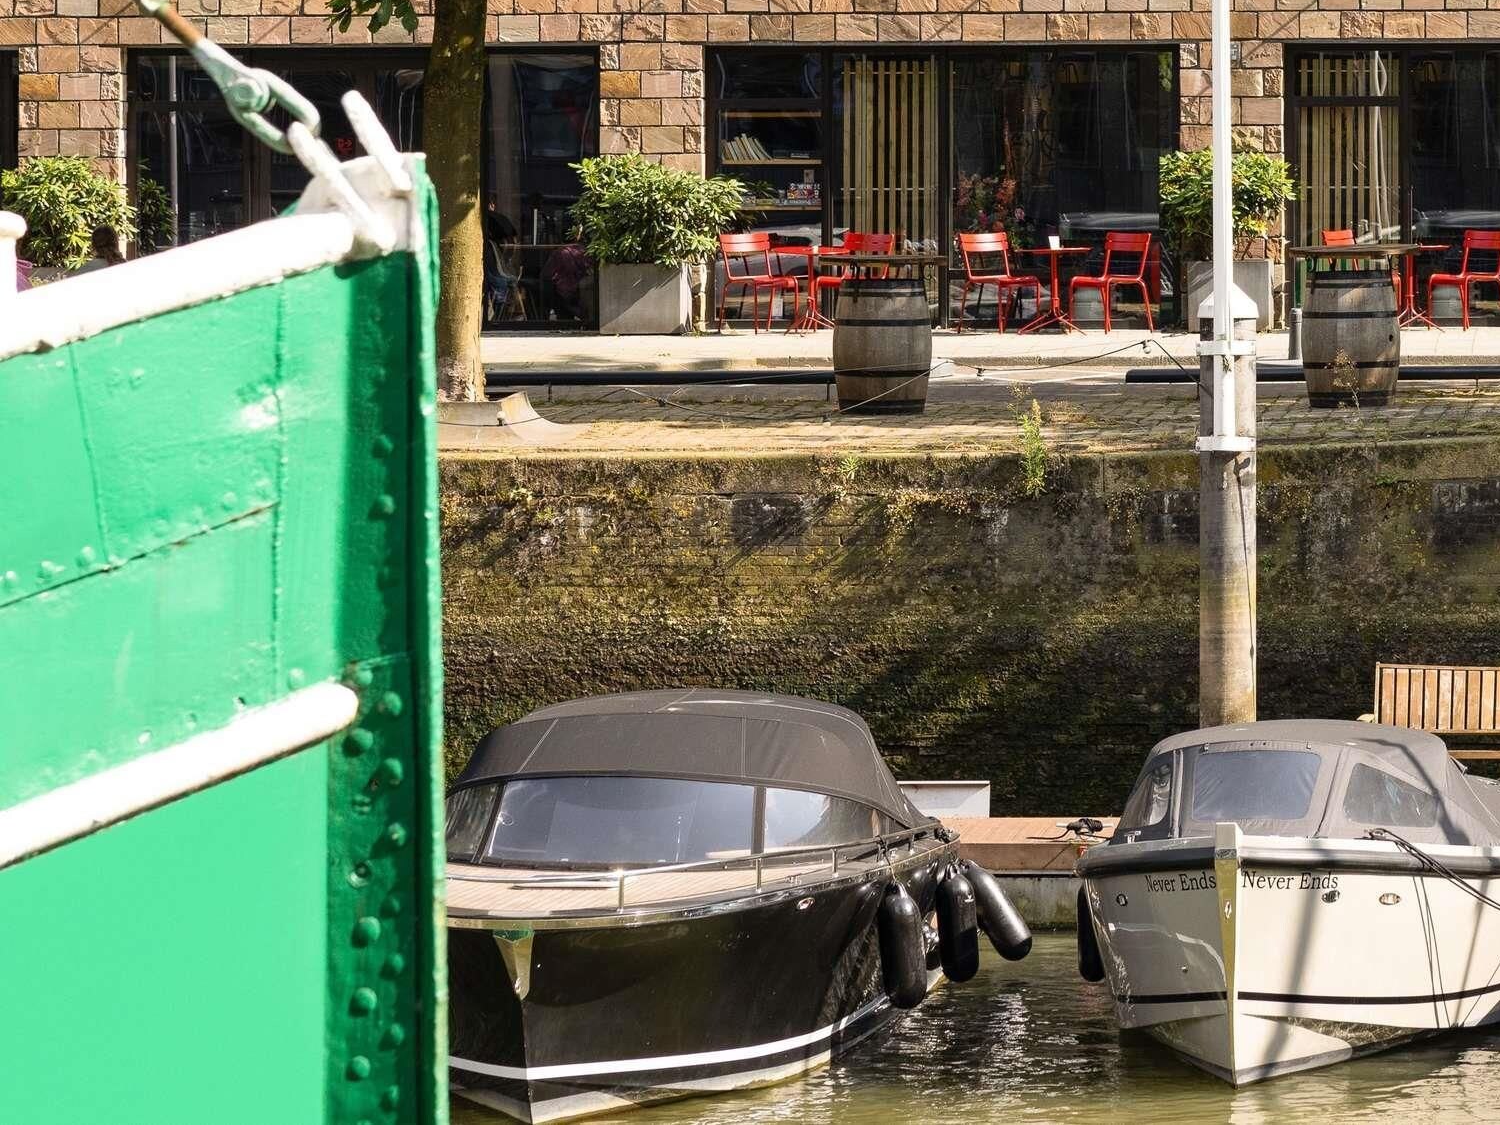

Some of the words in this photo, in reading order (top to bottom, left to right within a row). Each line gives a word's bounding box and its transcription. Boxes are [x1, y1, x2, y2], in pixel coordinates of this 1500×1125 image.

[1145, 874, 1176, 892] Never
[1179, 871, 1216, 892] Ends
[1242, 870, 1294, 890] Never
[1299, 870, 1339, 890] Ends
